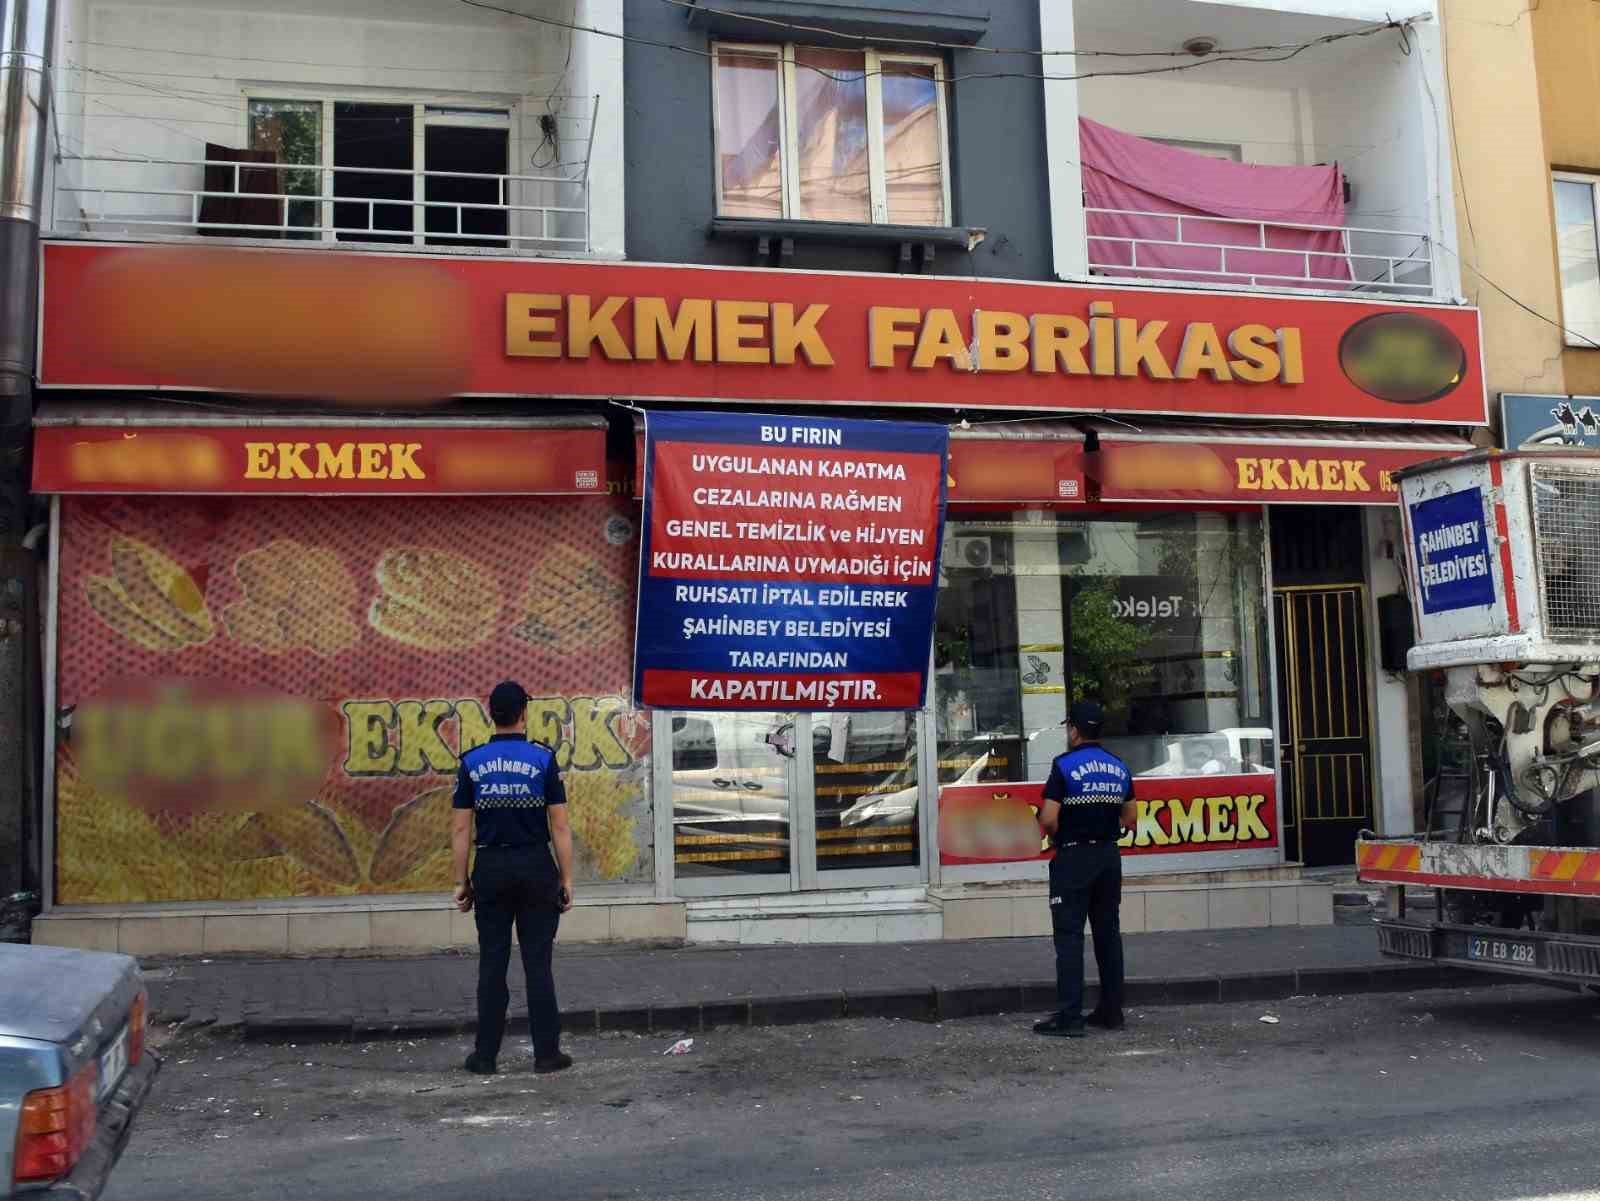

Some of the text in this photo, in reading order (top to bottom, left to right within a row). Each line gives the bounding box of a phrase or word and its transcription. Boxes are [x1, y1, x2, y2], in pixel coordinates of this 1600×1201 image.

[505, 292, 835, 367] EKMEK
[868, 300, 1305, 385] FABRİKASI
[761, 426, 842, 446] BU FIRIN
[244, 442, 426, 480] EKMEK
[692, 456, 906, 481] UYGULANAN KAPATMA
[1235, 457, 1371, 492] EKMEK
[693, 488, 902, 512] CEZALARINA RAĞMEN
[666, 519, 924, 545] GENEL TEMİZLİK ve HİJYEN
[653, 551, 931, 581] KURALLARINA UYMADIĞI İÇİN
[1420, 549, 1488, 587] BELEDİYESİ
[675, 583, 908, 607] RUHSATI İPTAL EDİLEREK
[683, 614, 891, 639] ŞAHİNBEY BELEDİYESİ
[729, 650, 848, 669] TARAFINDAN
[690, 679, 882, 707] KAPATILMIŞTIR.
[480, 783, 531, 795] ZABITA
[1082, 782, 1123, 793] ZABITA
[1475, 940, 1488, 957] 27
[1512, 944, 1535, 962] 282
